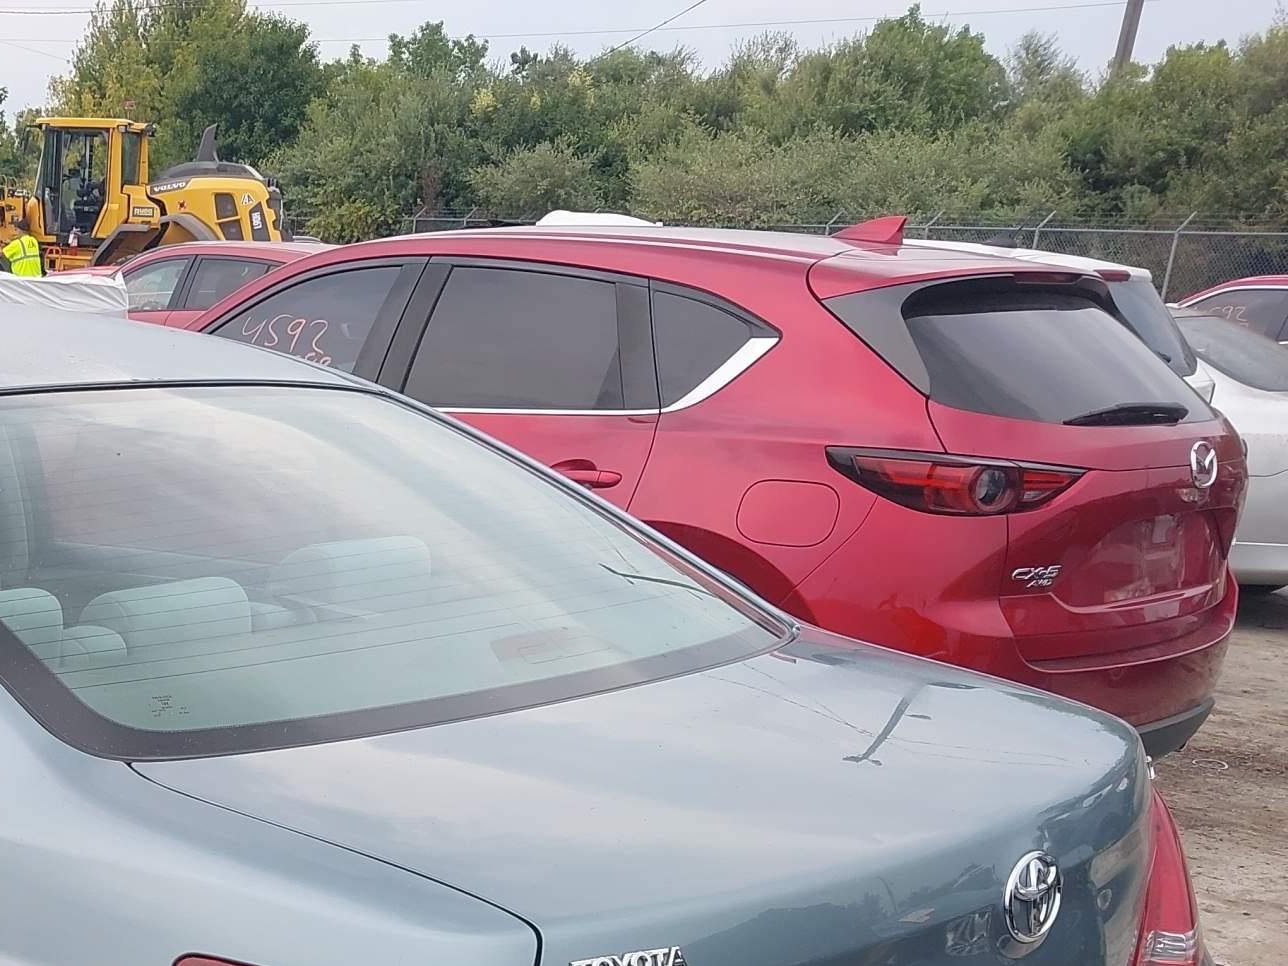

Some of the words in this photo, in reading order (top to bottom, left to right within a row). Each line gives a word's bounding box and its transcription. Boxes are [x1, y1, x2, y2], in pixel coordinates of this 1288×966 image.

[152, 181, 187, 193] VOLVO
[242, 314, 329, 354] 4592
[1012, 565, 1063, 581] CX-5
